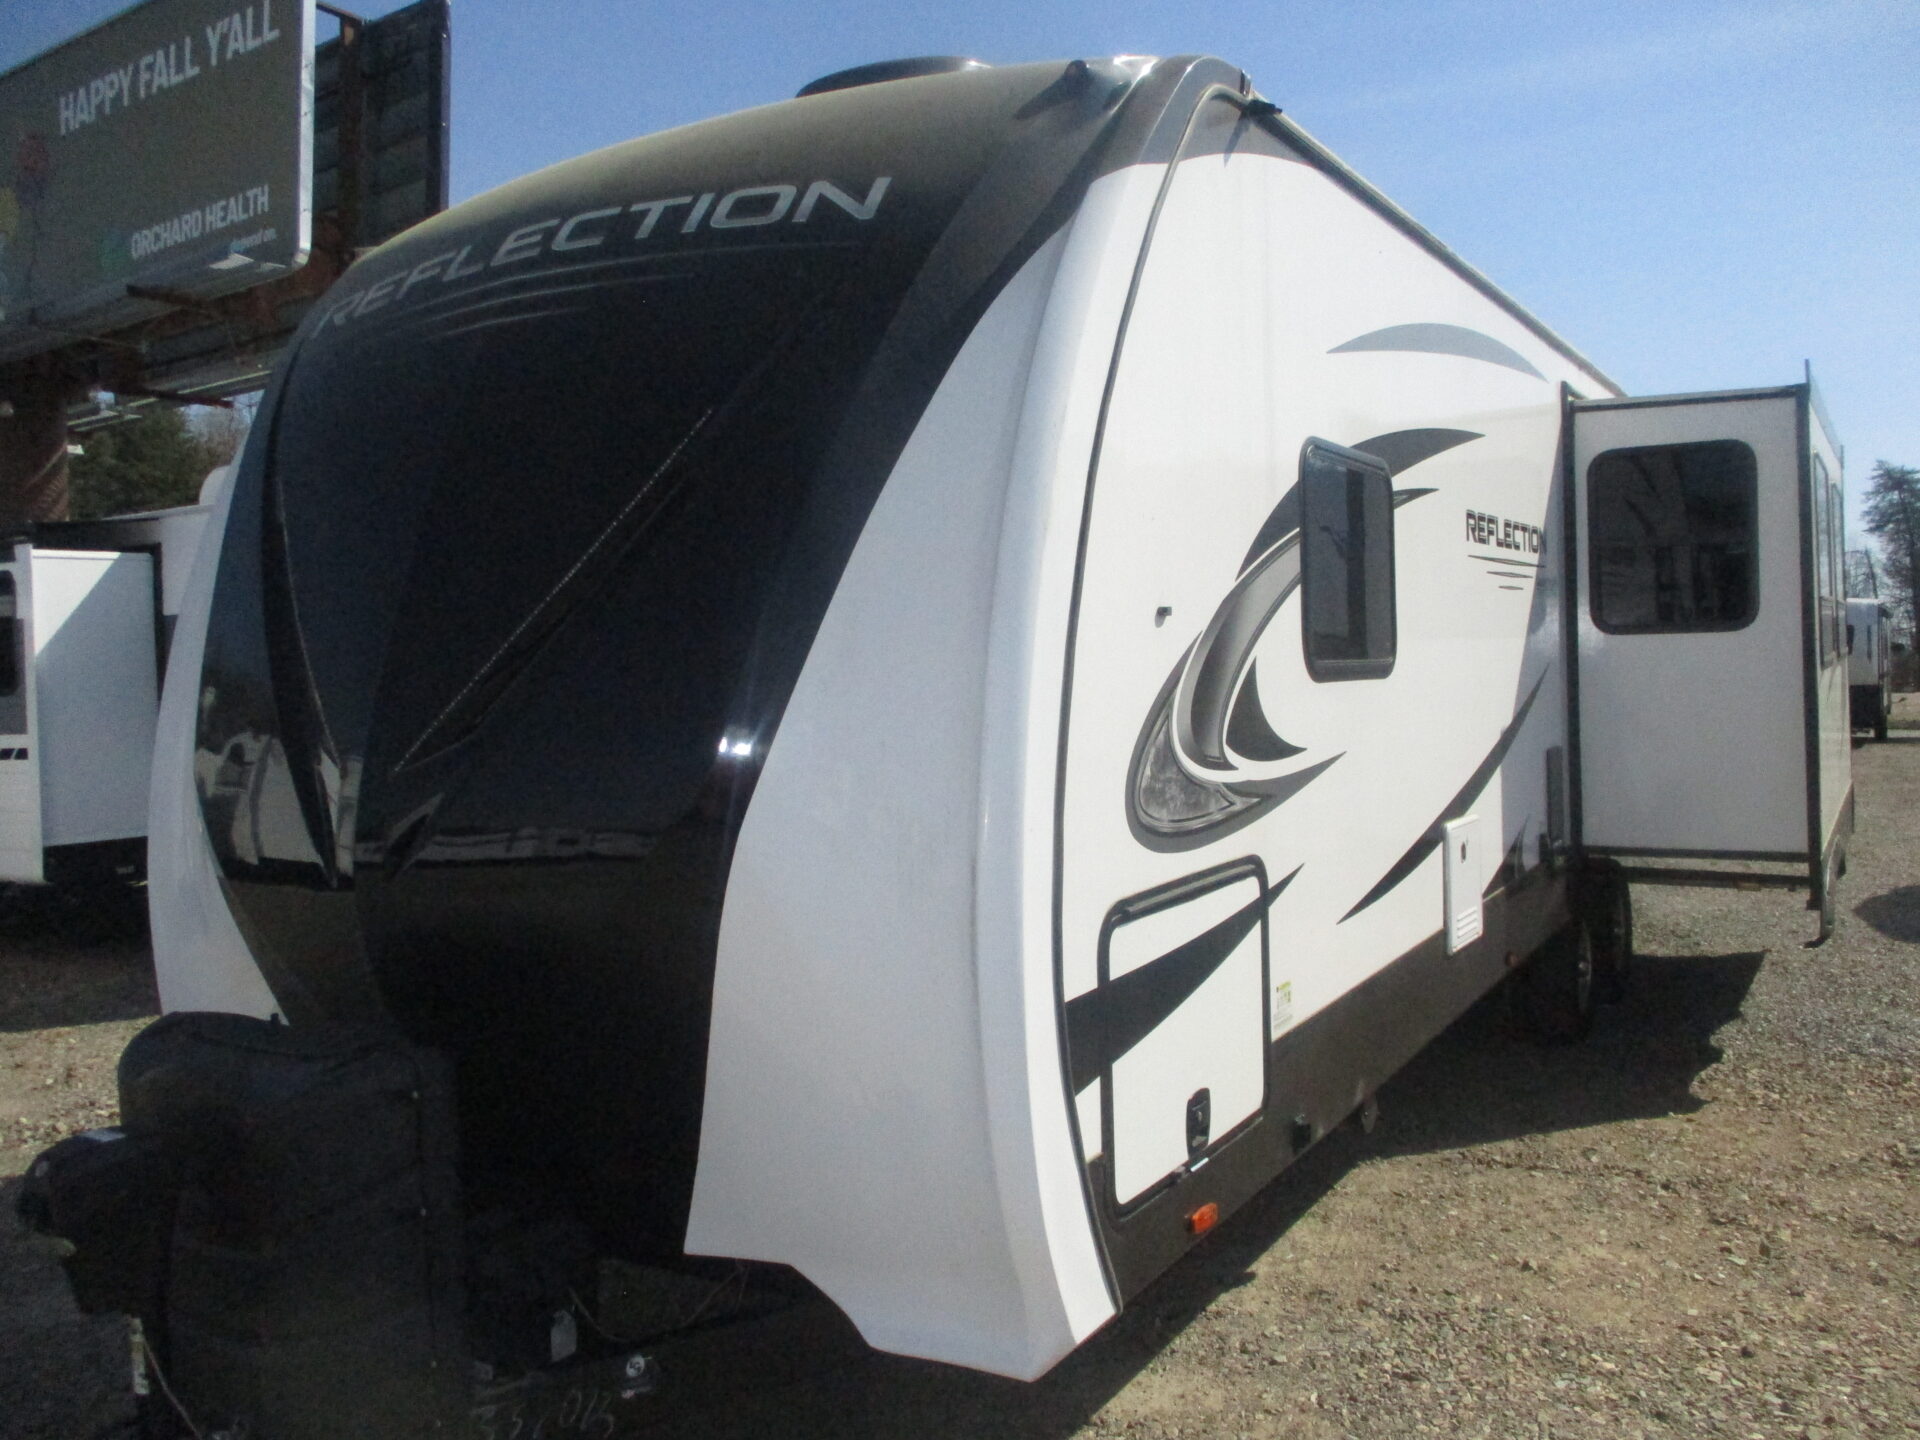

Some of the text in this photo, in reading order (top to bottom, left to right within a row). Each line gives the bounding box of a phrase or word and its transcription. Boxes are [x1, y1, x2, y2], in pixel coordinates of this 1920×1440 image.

[59, 0, 281, 136] HAPPY FALL Y'ALL
[130, 209, 202, 260] ORCHARD
[205, 184, 270, 233] HEALTH
[311, 176, 892, 338] REFLECTION
